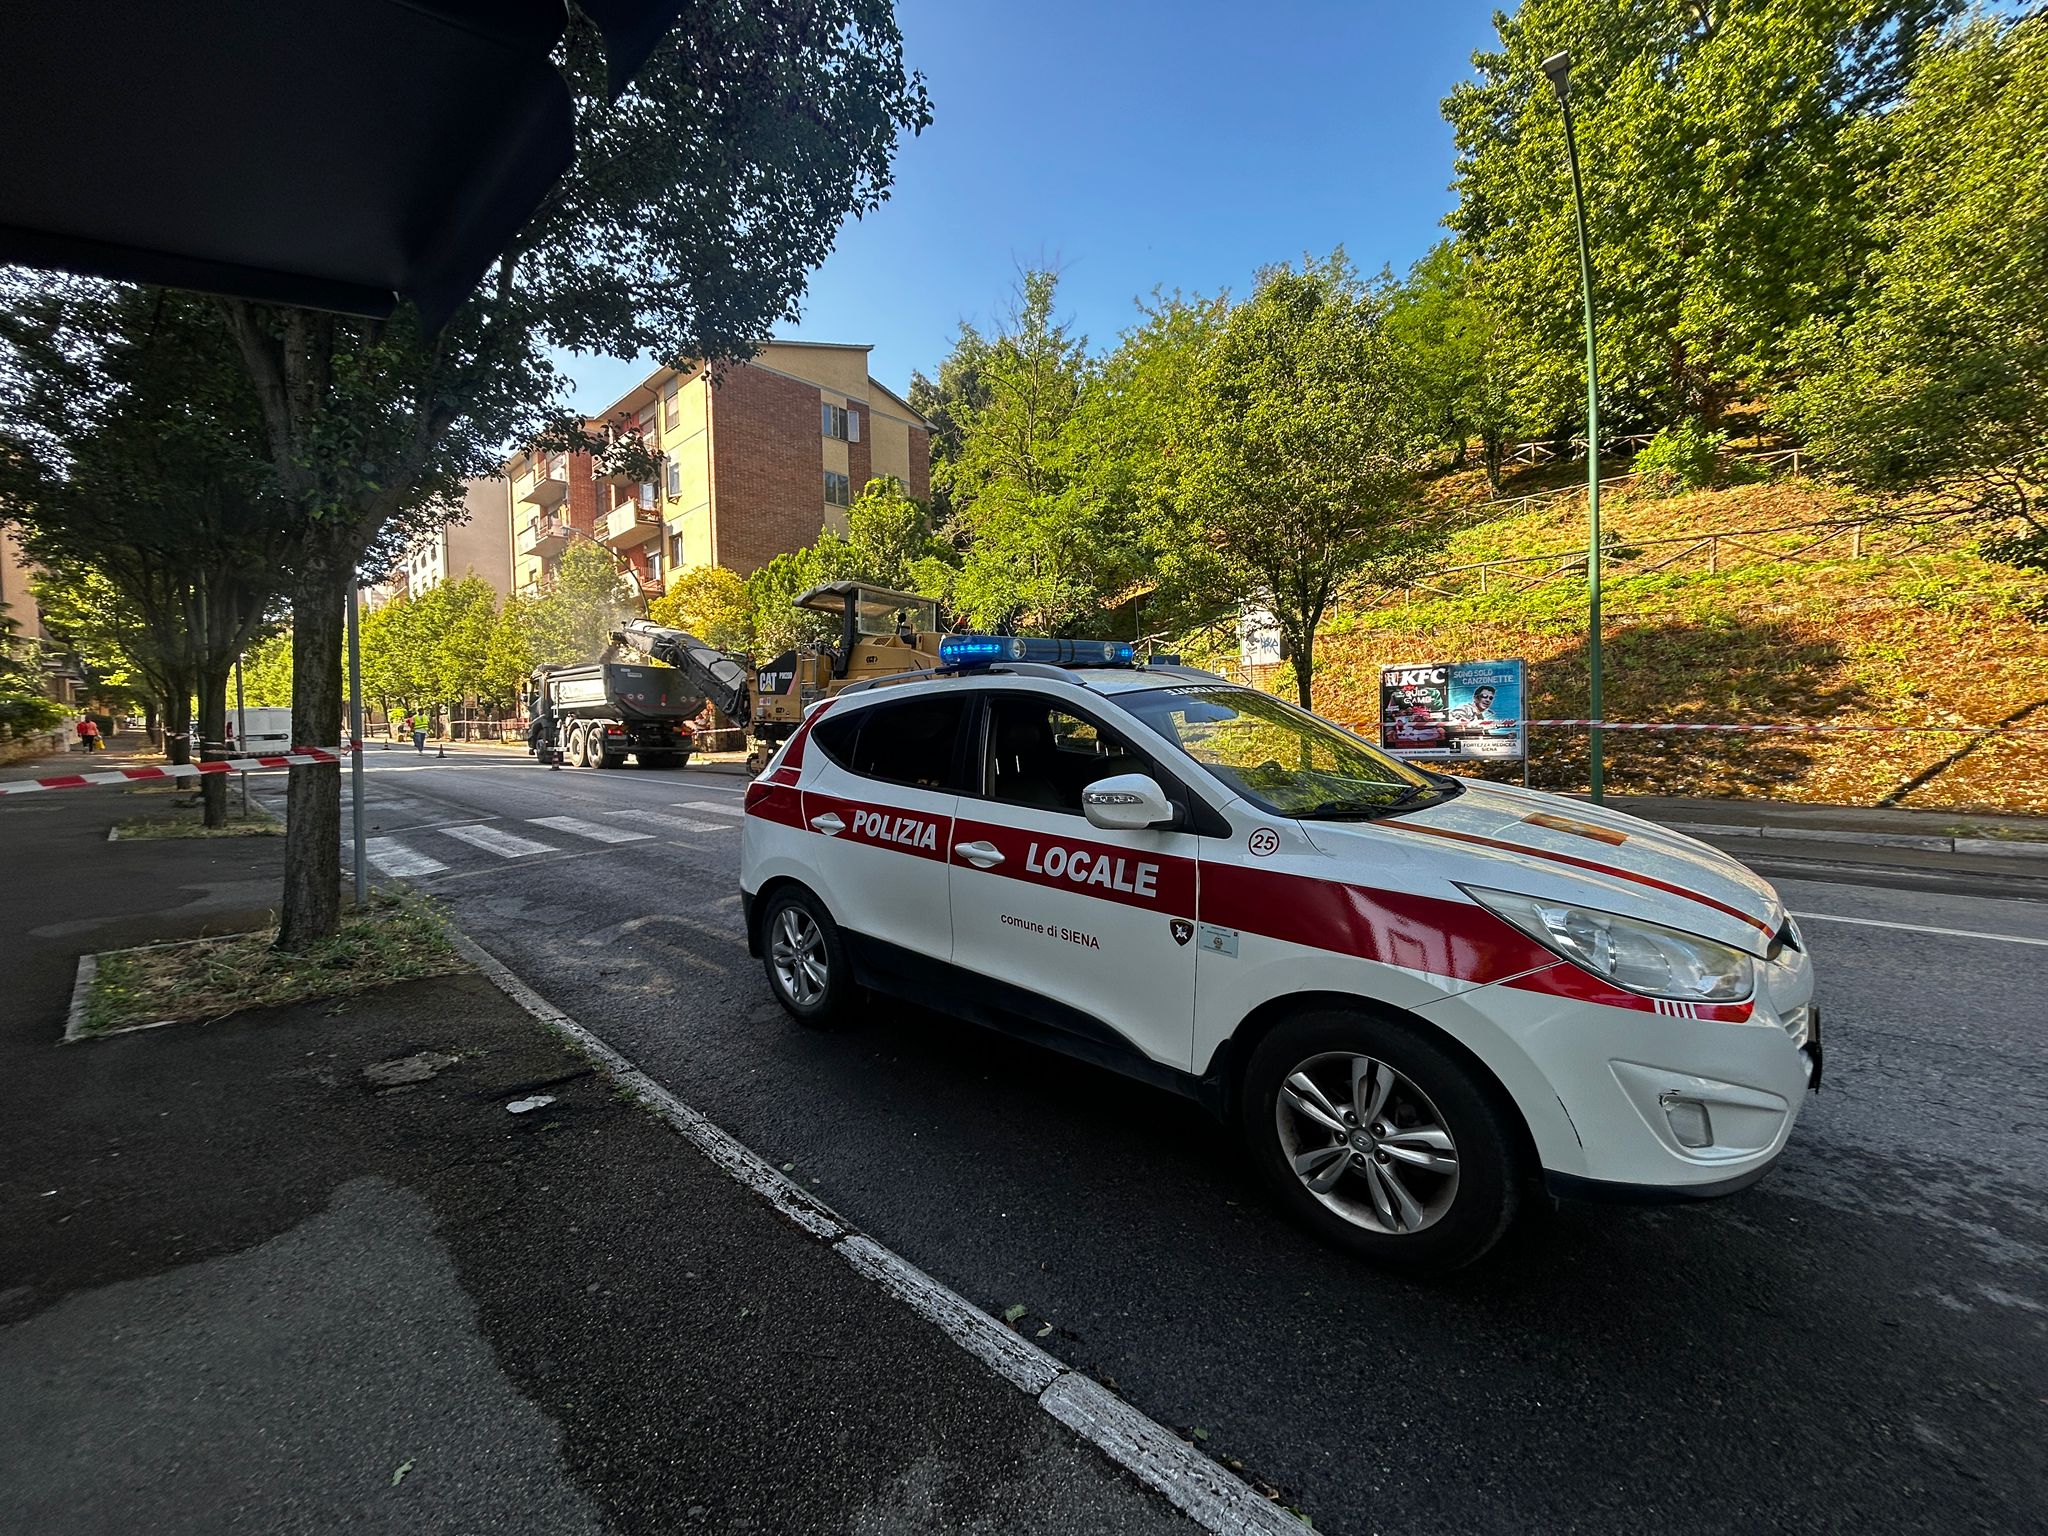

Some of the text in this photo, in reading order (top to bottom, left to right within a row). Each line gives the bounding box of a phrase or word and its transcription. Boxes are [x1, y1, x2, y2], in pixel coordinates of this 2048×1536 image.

[760, 672, 777, 692] CAT
[1399, 668, 1446, 686] KFC
[1453, 671, 1473, 679] SONO
[1474, 669, 1493, 677] SOLO
[1462, 675, 1514, 685] CANZONETTE
[852, 809, 937, 851] POLIZIA
[1252, 834, 1275, 850] 25
[1025, 842, 1160, 898] LOCALE
[1000, 914, 1100, 950] comune di SIENA
